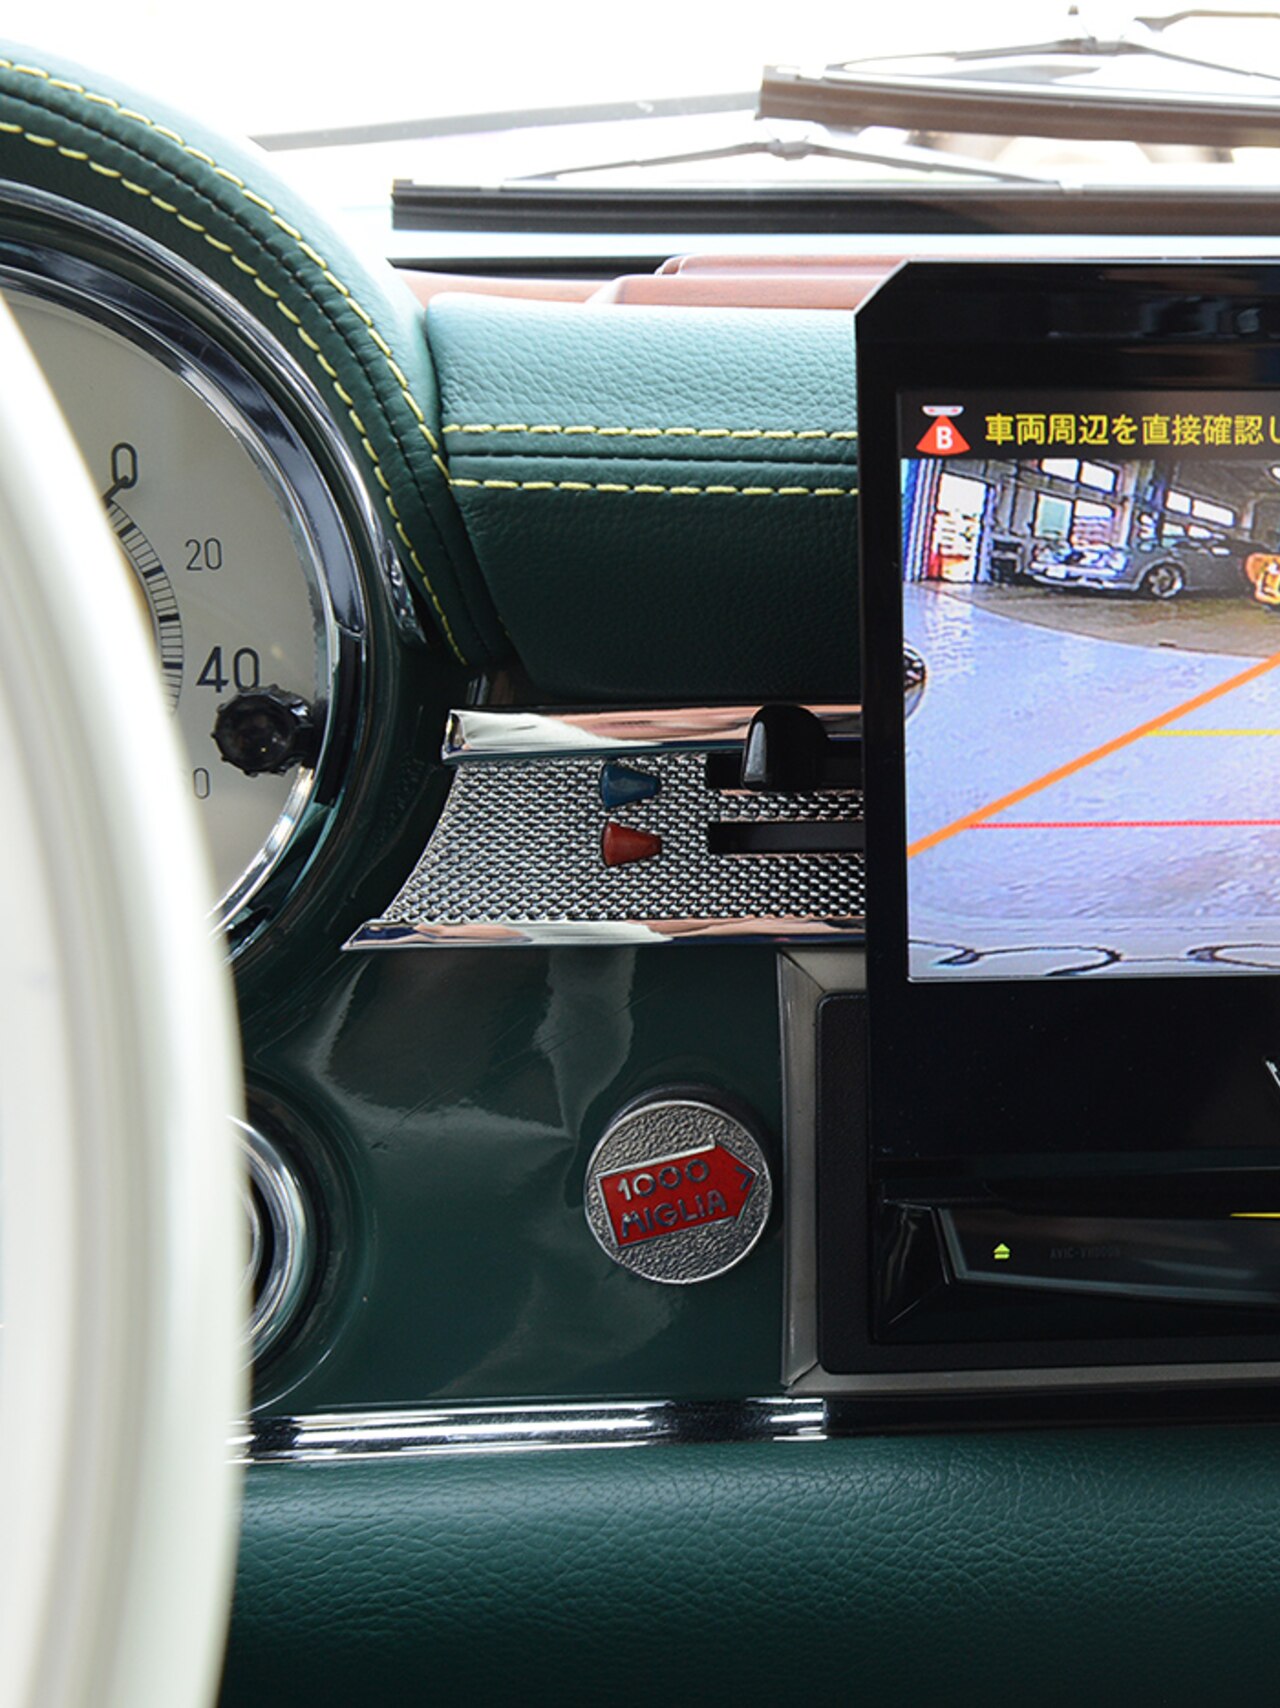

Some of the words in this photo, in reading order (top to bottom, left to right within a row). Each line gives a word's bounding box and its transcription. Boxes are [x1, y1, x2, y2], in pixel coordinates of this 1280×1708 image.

[936, 425, 953, 450] B
[185, 538, 222, 571] 20
[196, 646, 260, 692] 40
[617, 1158, 710, 1201] 1000
[621, 1189, 727, 1237] MIGLIA
